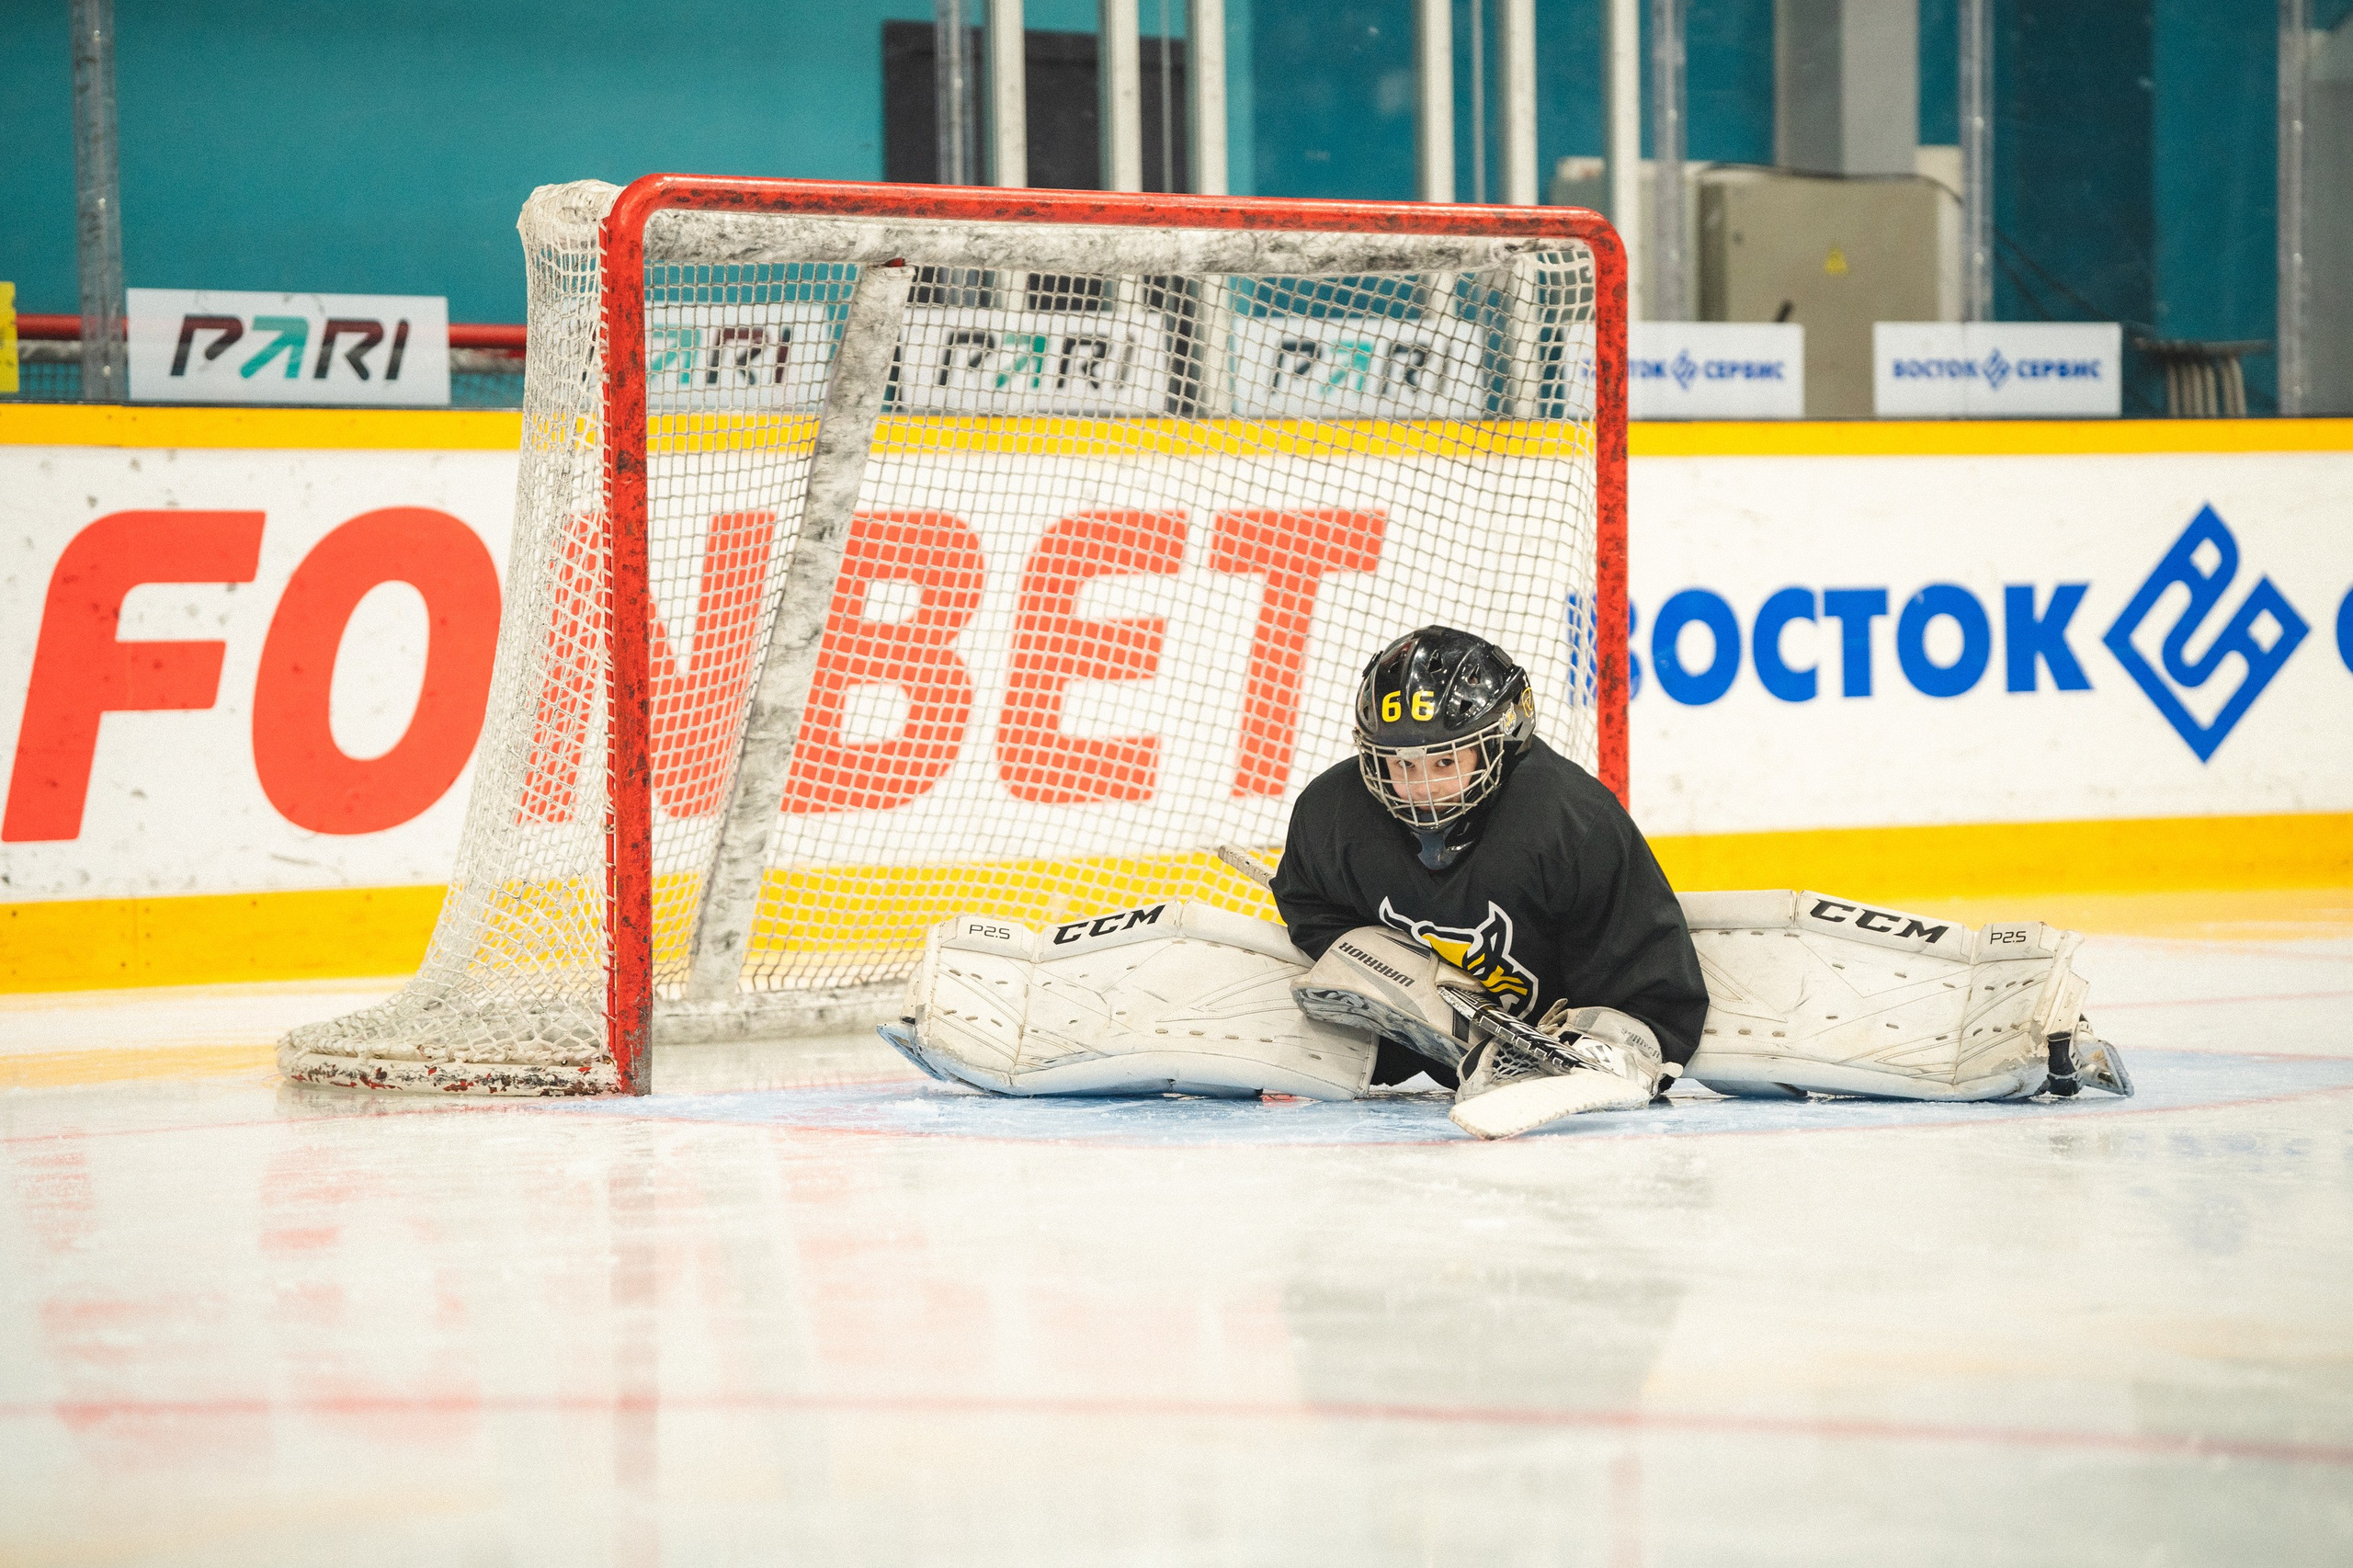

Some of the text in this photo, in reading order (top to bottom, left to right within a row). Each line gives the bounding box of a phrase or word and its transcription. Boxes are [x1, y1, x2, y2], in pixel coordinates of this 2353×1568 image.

[171, 314, 410, 381] PARI
[582, 324, 791, 386] ARI
[938, 332, 1134, 390] PARI
[1703, 358, 1784, 381] СЕРВИС
[1892, 357, 2102, 380] ВОСТОК СЕРВИС
[0, 505, 1386, 843] FONBET
[1381, 690, 1435, 722] 66
[1053, 904, 1166, 945] CCM
[1809, 898, 1950, 944] CCM
[1338, 941, 1415, 988] WARRIOR
